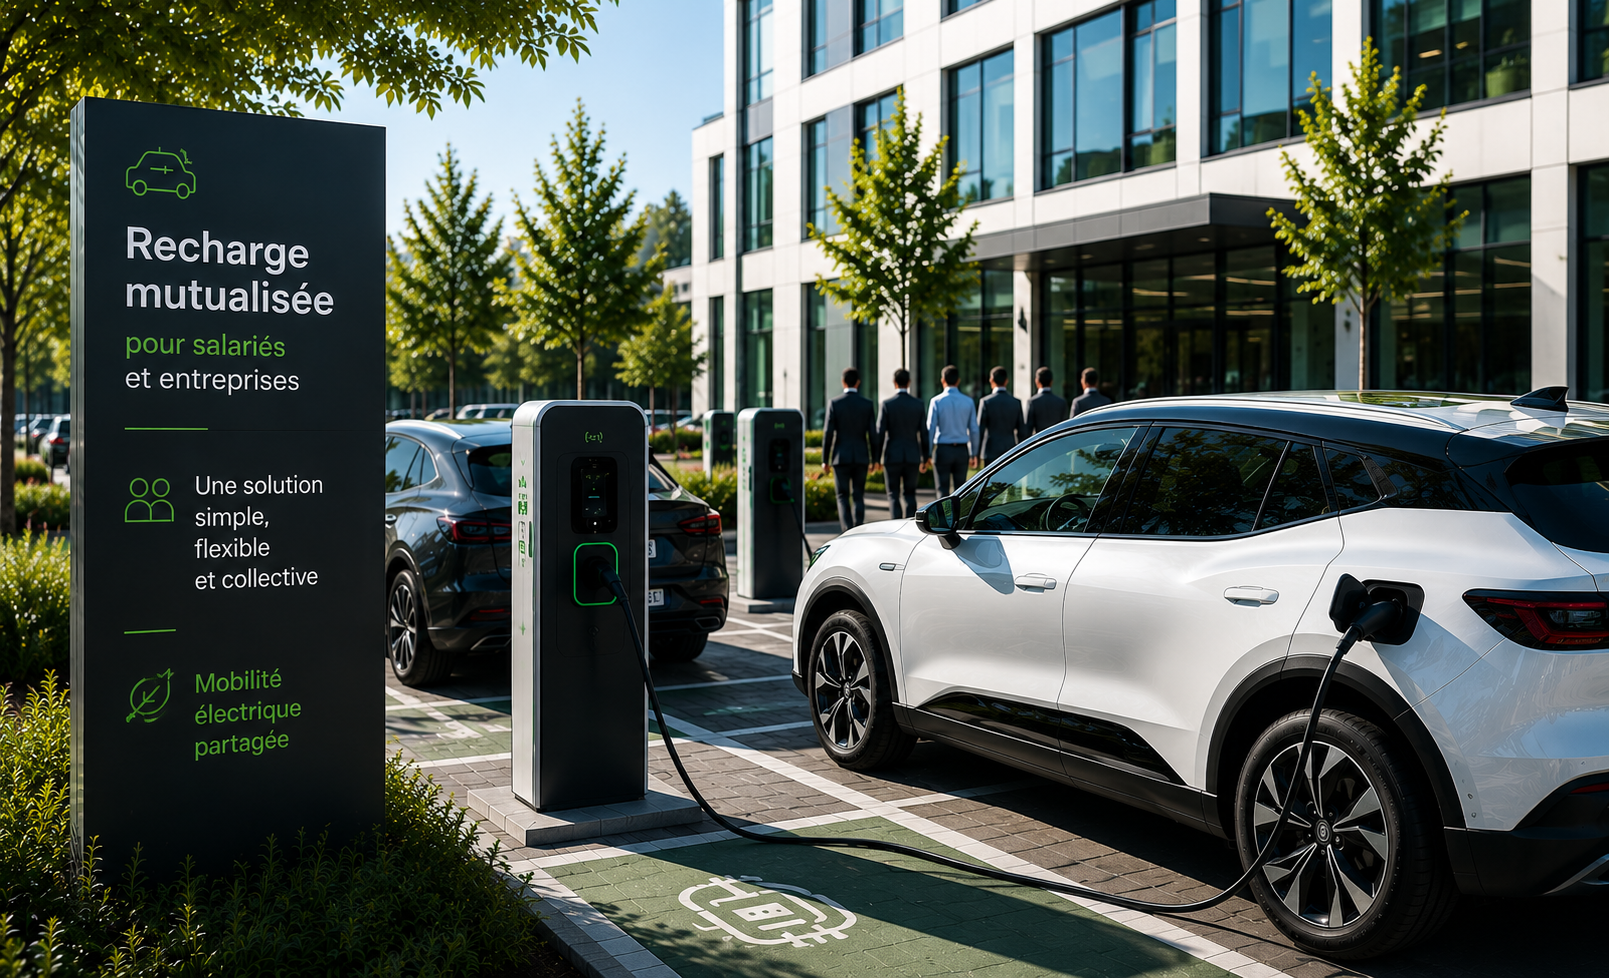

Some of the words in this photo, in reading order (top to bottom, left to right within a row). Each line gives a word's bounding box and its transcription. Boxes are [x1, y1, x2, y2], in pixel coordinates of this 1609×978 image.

[127, 226, 309, 275] Recharge
[127, 280, 334, 315] mutualisée
[126, 336, 185, 359] pour
[193, 333, 286, 357] salariés
[125, 368, 151, 388] et
[160, 369, 300, 395] entreprises
[195, 475, 237, 495] Une
[243, 475, 323, 494] solution
[195, 506, 269, 530] simple,
[194, 537, 270, 558] flexible
[195, 571, 216, 589] et
[222, 567, 318, 588] collective
[195, 668, 282, 693] Mobilité
[195, 701, 301, 724] électrique
[195, 730, 290, 761] partagée
